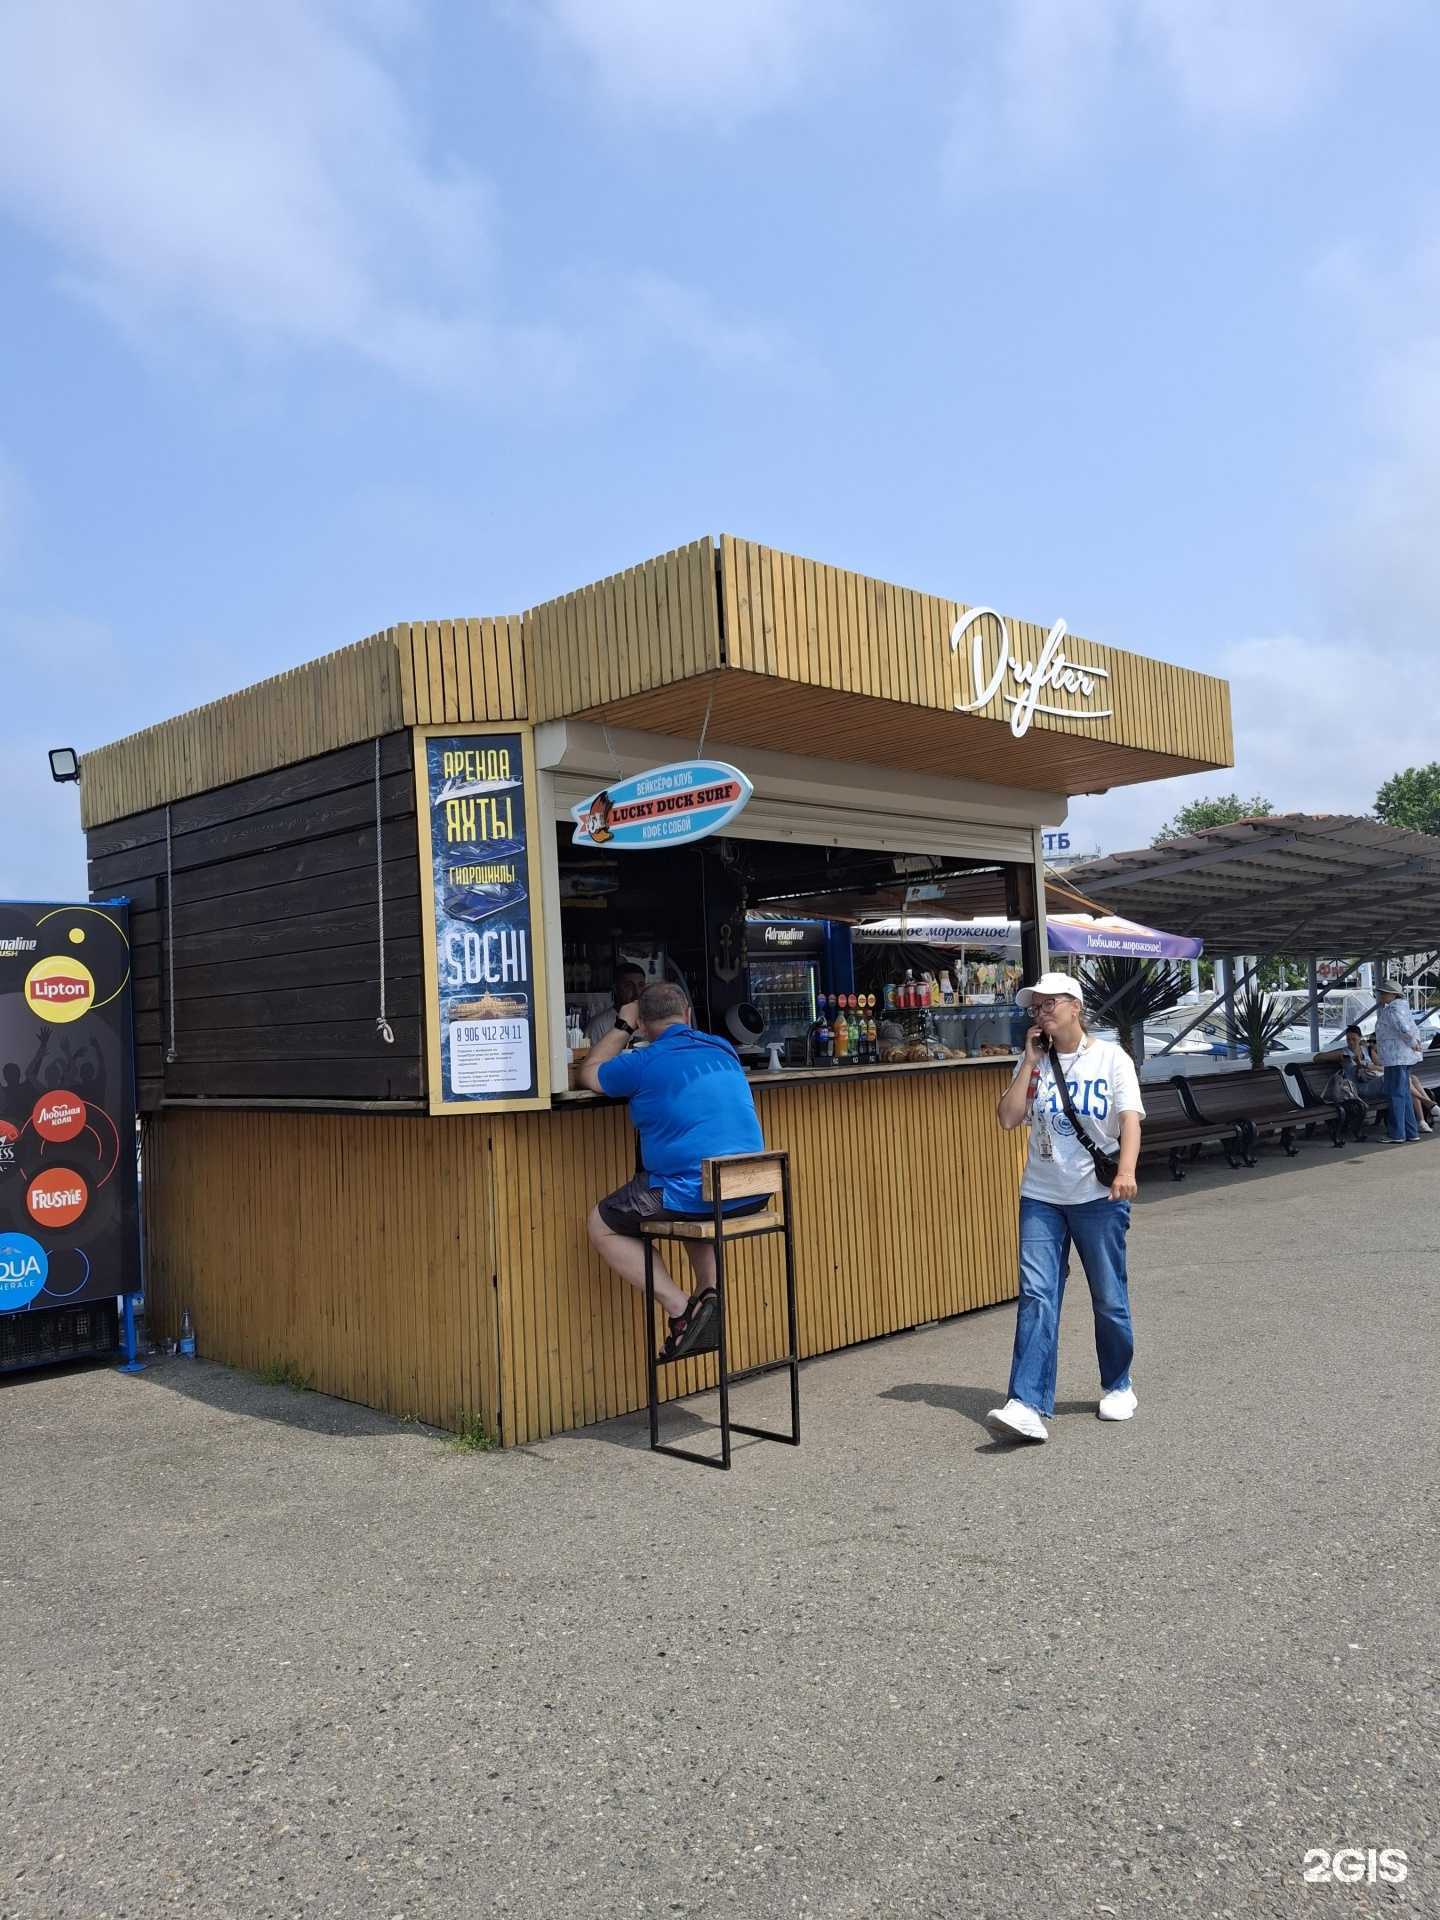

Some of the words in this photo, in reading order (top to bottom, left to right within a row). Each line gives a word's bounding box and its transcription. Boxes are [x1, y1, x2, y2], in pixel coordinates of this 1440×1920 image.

[951, 606, 1112, 738] Drifter
[443, 749, 510, 780] АРЕНДА
[673, 770, 693, 786] КЛУБ
[612, 800, 654, 822] LUCKY
[656, 793, 694, 813] DUCK
[696, 785, 734, 805] SURF
[446, 797, 513, 842] ЯХТЫ
[642, 822, 663, 839] КОФЕ
[668, 815, 692, 834] СОБОЙ
[1041, 832, 1071, 850] ТБ
[449, 864, 515, 885] ГИДРОЦИКЛЫ
[0, 936, 37, 951] naline
[447, 930, 527, 985] SOCHI
[35, 982, 85, 999] Lipton
[456, 1028, 462, 1042] 8
[464, 1027, 480, 1042] 906
[481, 1026, 497, 1041] 412
[499, 1025, 510, 1040] 24
[512, 1025, 522, 1040] 11
